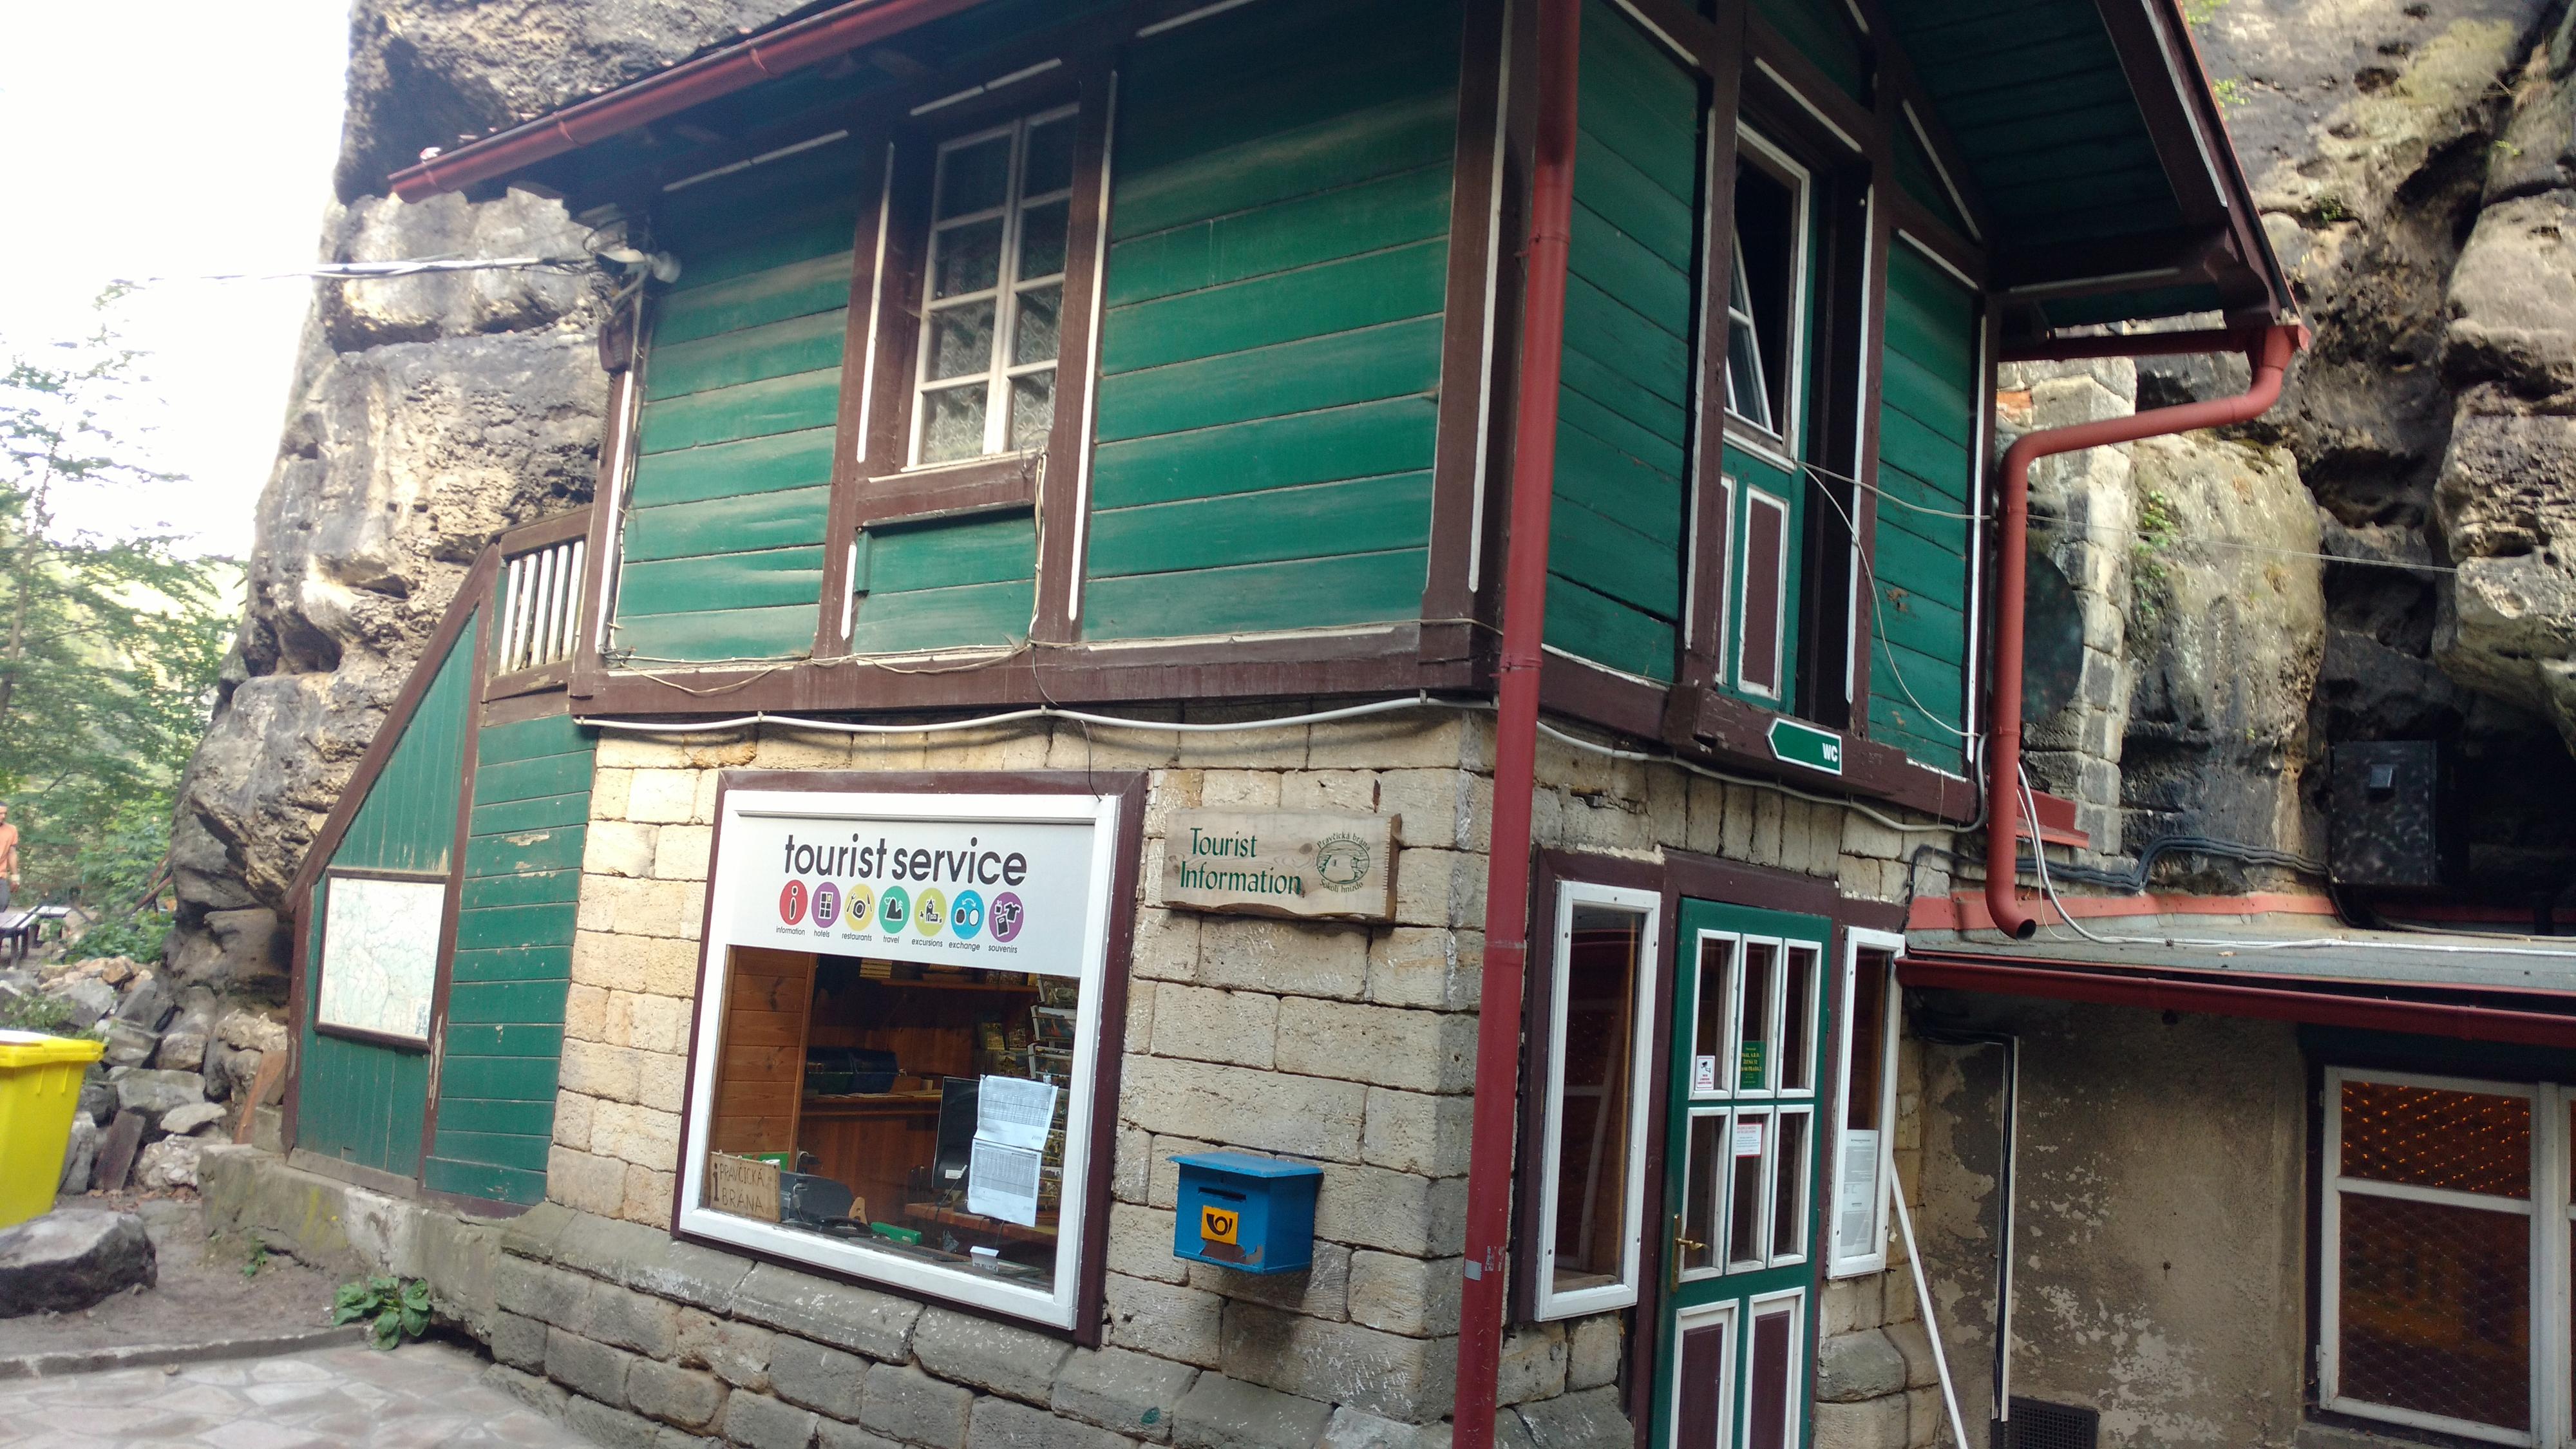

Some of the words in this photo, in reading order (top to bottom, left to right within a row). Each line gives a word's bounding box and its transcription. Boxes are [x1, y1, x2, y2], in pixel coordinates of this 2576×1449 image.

[1822, 742, 1838, 762] WC
[1190, 827, 1257, 858] Tourist
[1180, 860, 1302, 896] Information
[775, 926, 806, 936] information
[813, 929, 830, 938] hotels
[841, 933, 873, 942] restaurants
[883, 935, 900, 943] travel
[911, 938, 943, 947] excursions
[948, 942, 981, 952] exchange
[988, 944, 1018, 954] souvenirs
[719, 1162, 764, 1187] PRAVČICKÁ
[722, 1188, 764, 1213] BRÁNA
